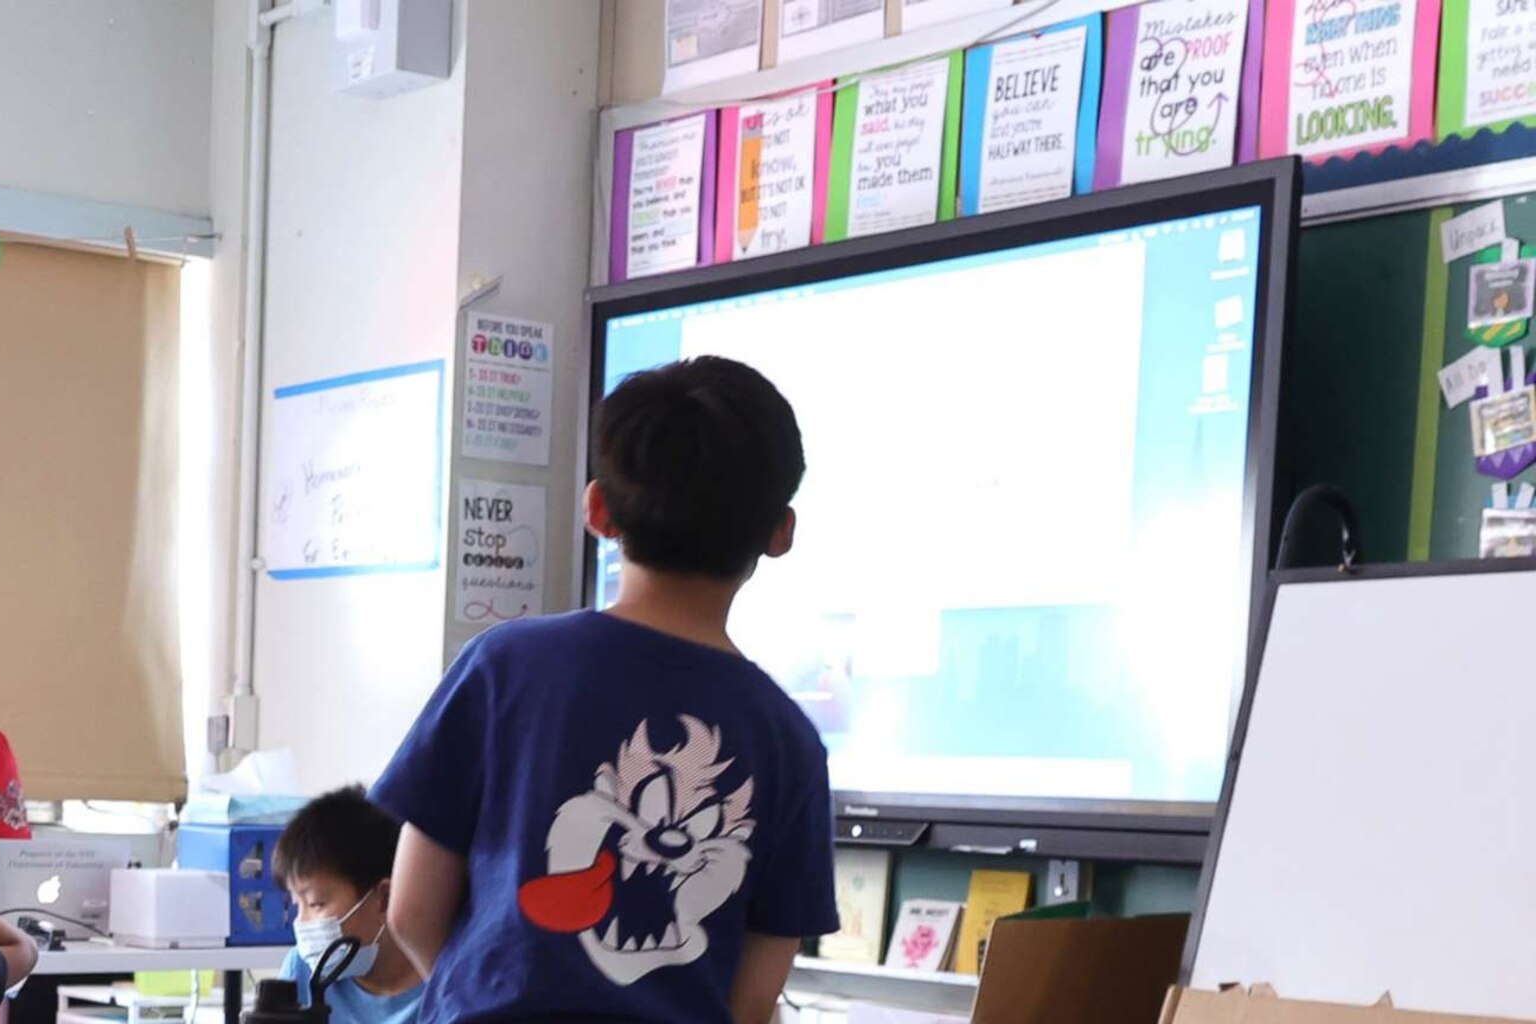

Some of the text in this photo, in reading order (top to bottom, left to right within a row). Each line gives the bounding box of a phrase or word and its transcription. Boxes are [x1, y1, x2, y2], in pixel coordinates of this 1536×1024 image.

[1144, 10, 1237, 39] Mistakes
[1140, 31, 1232, 71] are PROOF
[1349, 38, 1399, 63] when
[994, 64, 1061, 102] BELIEVE
[1139, 68, 1225, 98] that you
[864, 93, 928, 116] what you
[1160, 97, 1199, 118] are
[874, 153, 901, 173] you
[857, 166, 932, 192] made them
[464, 496, 513, 522] NEVER
[463, 525, 506, 556] stop
